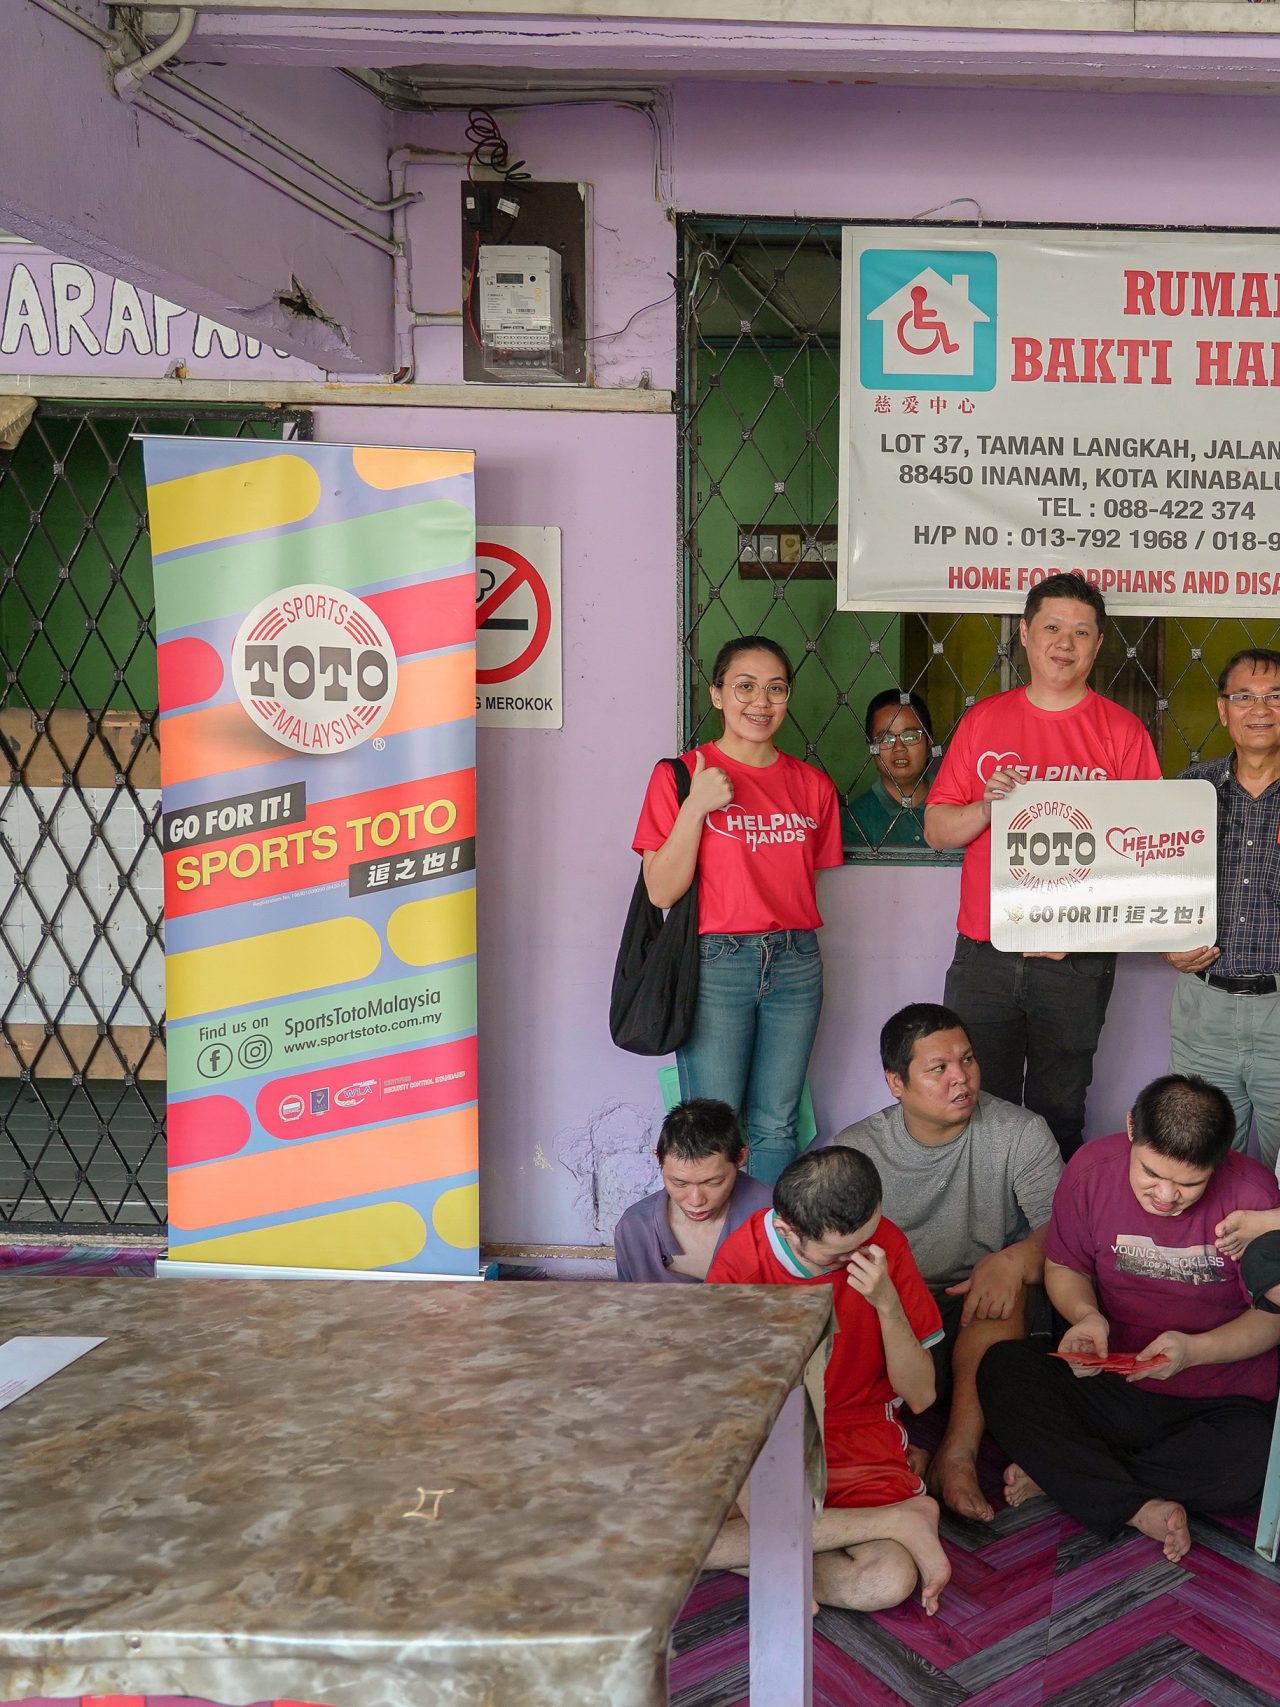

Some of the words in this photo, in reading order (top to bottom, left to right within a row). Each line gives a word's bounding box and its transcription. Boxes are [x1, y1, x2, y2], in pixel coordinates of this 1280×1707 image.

[1, 262, 290, 358] ARAP
[1011, 336, 1172, 384] BAKTI
[873, 394, 976, 415] 慈爱中心
[880, 433, 925, 454] LOT
[933, 435, 970, 457] 37,
[977, 436, 1065, 458] TAMAN
[1073, 437, 1197, 462] LANGKAH,
[898, 464, 974, 486] 88450
[982, 466, 1088, 490] INANAM,
[1095, 468, 1158, 490] KOTA
[1038, 497, 1081, 519] TEL
[1103, 498, 1205, 521] 088-422
[1212, 500, 1256, 521] 374
[913, 525, 957, 547] H/P
[964, 525, 999, 547] NO
[1020, 527, 1122, 550] 013-792
[1129, 529, 1187, 551] 1968
[948, 566, 1011, 591] HOME
[1070, 568, 1178, 594] RPHANS
[1183, 571, 1229, 594] AND
[282, 594, 348, 625] SPORTS
[245, 644, 388, 702] TOTO
[485, 697, 553, 711] MEROKOK
[273, 708, 364, 749] MALAYSIA
[169, 814, 200, 843] GO
[205, 803, 254, 835] FOR
[261, 792, 291, 823] IT!
[727, 813, 818, 831] HELPING
[1029, 801, 1072, 819] SPORTS
[176, 825, 338, 891] SPORTS
[346, 799, 457, 852] TOTO
[746, 829, 805, 852] HANDS
[1007, 832, 1096, 866] TOTO
[1122, 829, 1205, 852] HELPING
[1135, 846, 1185, 867] HANDS
[1029, 905, 1053, 923] GO
[1058, 905, 1092, 923] FOR
[1096, 905, 1118, 923] IT!
[284, 988, 441, 1040] SportsTotoMalaysia
[199, 1022, 227, 1042] Find
[232, 1021, 247, 1034] us
[252, 1016, 269, 1031] on
[284, 1012, 442, 1054] www.sportstoto.com.my
[1111, 1245, 1156, 1259] YOUNG
